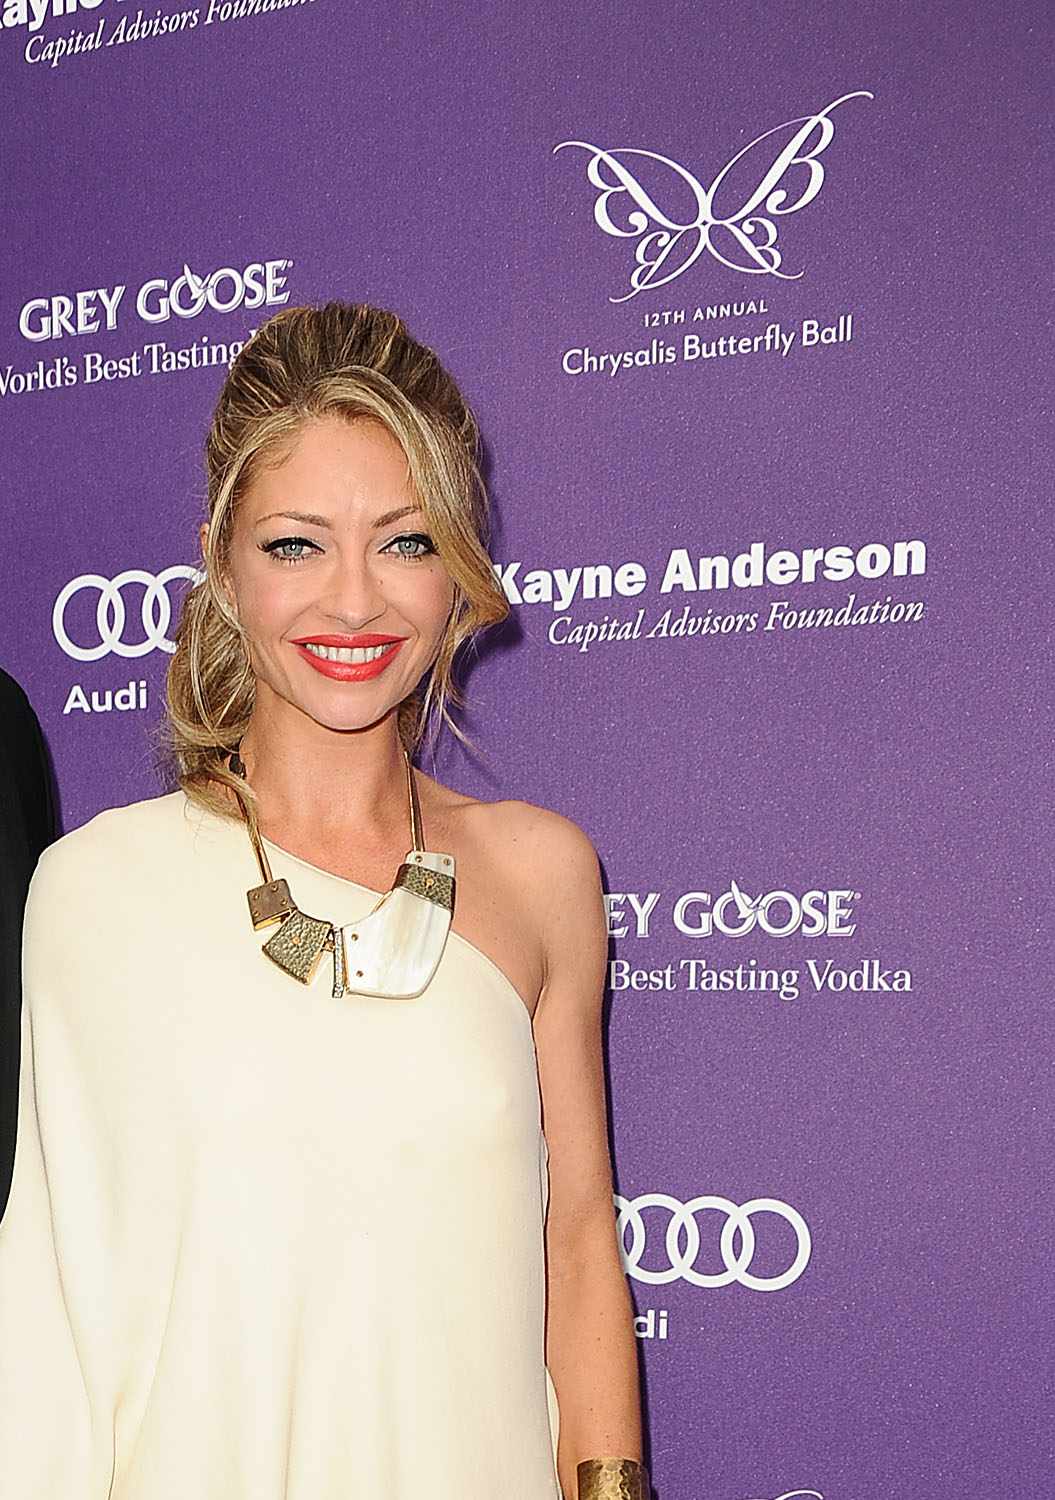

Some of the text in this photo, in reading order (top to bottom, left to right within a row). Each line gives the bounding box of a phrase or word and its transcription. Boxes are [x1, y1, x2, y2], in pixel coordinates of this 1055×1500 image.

[24, 19, 105, 68] Capital
[106, 8, 200, 47] Advisors
[19, 260, 292, 342] GREY GOOSE
[644, 300, 769, 328] 12TH ANNUAL
[83, 350, 142, 384] Best
[562, 315, 853, 377] Chrysalis Butterfly Ball
[491, 539, 928, 612] Kayne Anderson
[548, 595, 926, 652] Capital Advisors Foundation
[62, 681, 147, 714] Audi
[603, 879, 857, 939] EY GOOSE
[609, 958, 913, 1000] Best Tasting Vodka
[633, 1309, 668, 1340] di
